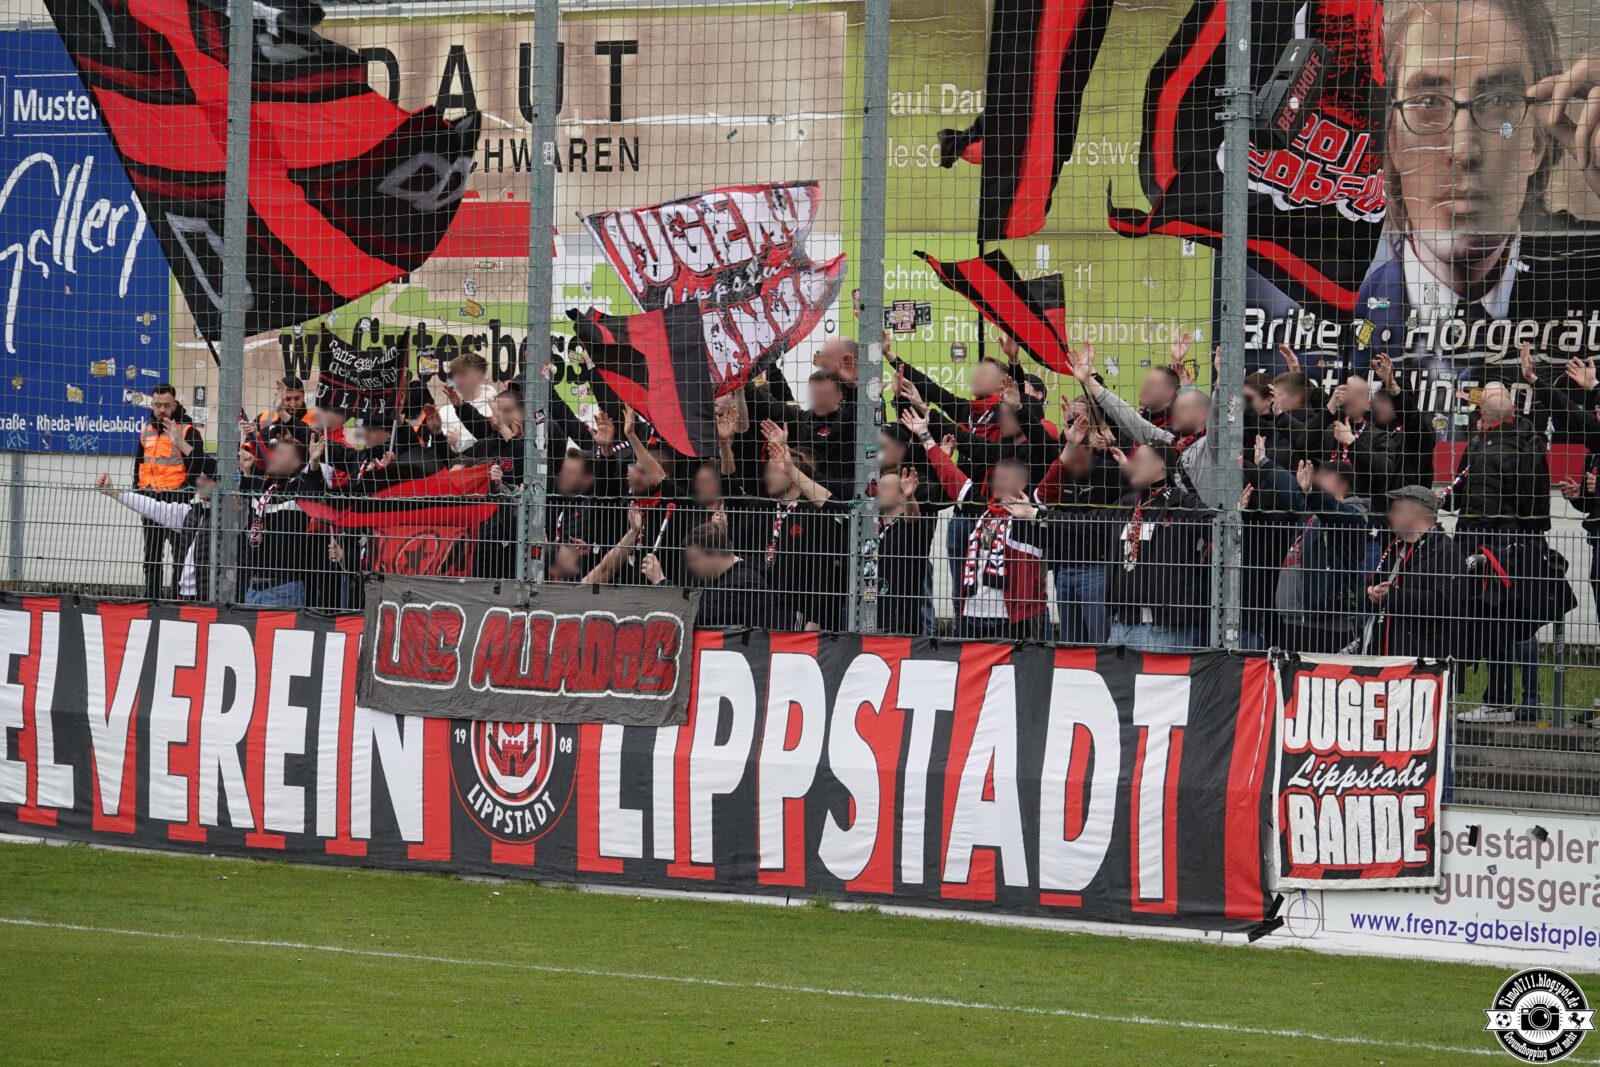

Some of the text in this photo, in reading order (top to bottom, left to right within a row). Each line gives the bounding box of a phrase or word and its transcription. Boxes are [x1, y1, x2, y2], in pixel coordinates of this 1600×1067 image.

[888, 84, 930, 115] aul
[1285, 675, 1437, 752] JUGEND
[454, 728, 573, 754] 19 08
[599, 649, 1192, 900] LIPPSTADT
[1288, 753, 1428, 796] Lippstadt
[466, 783, 557, 835] LIPPSTADT
[1288, 793, 1430, 866] BANDE
[1350, 911, 1600, 950] www.frenz-gabelstaple
